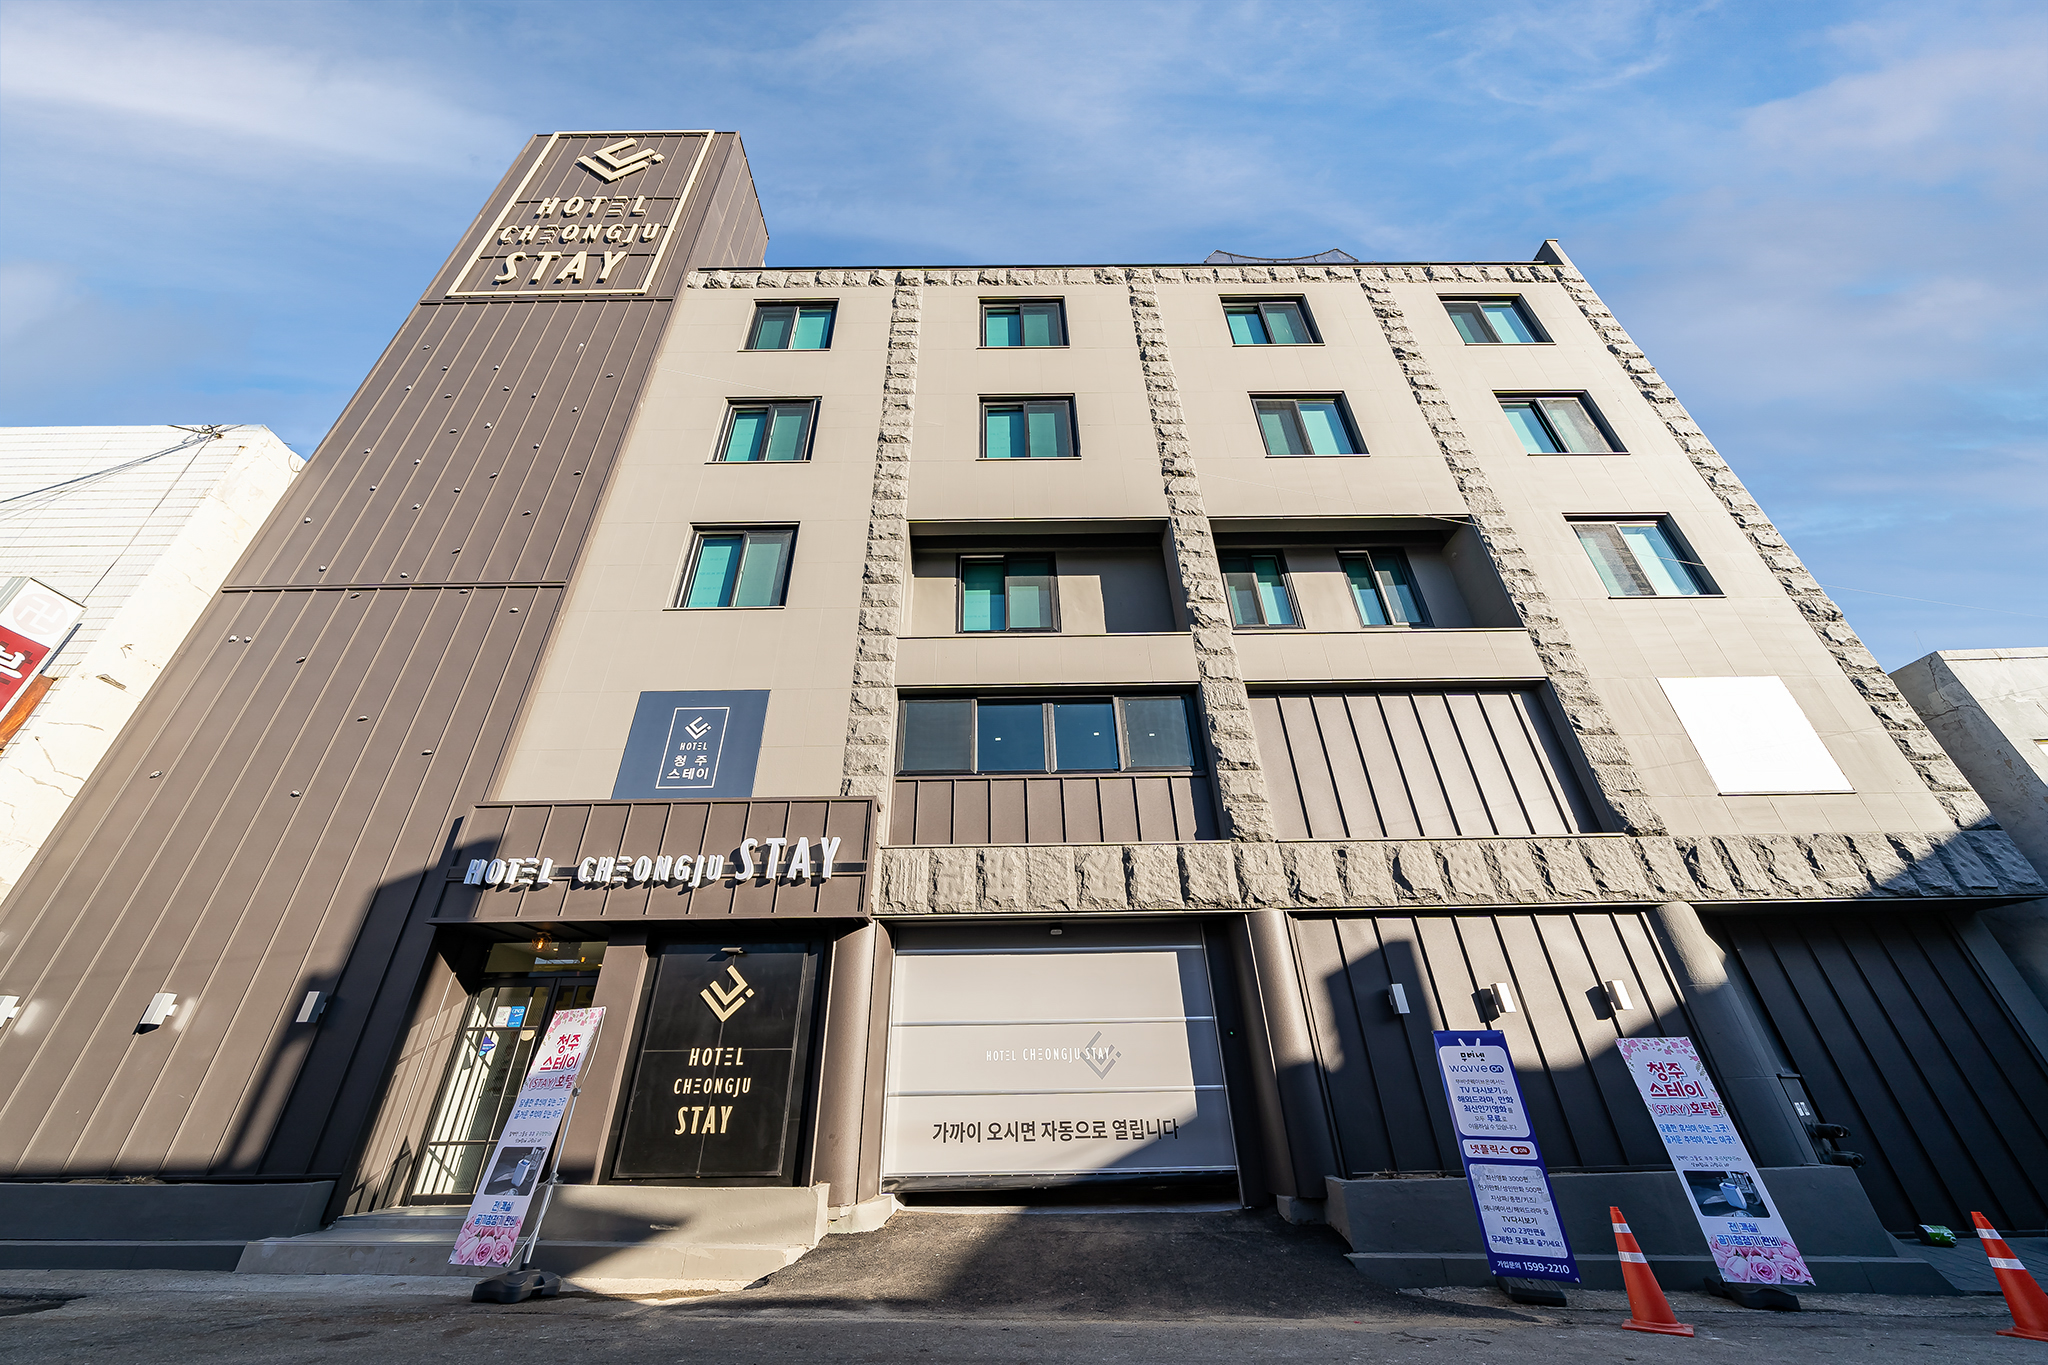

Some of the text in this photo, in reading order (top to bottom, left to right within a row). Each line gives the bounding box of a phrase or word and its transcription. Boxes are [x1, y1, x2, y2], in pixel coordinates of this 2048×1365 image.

[535, 195, 647, 216] HOTEL
[499, 223, 660, 245] CHEONGJU
[495, 250, 628, 284] STAY
[680, 742, 708, 751] HOTEL
[666, 768, 709, 780] 스테이
[463, 836, 842, 889] HOTEL CHEONGJU STAY
[556, 1034, 581, 1054] 청주
[540, 1053, 581, 1071] 스테이
[688, 1047, 744, 1066] HOTEL
[986, 1047, 1110, 1063] HOTEL CHEONGJU STAY
[1449, 1064, 1488, 1074] wavve
[1646, 1061, 1685, 1082] 청주
[529, 1074, 575, 1090] (STAY)호텔
[673, 1077, 751, 1098] CHEONGJU
[1649, 1080, 1704, 1097] 스테이
[1497, 1096, 1514, 1105] 만화
[1651, 1101, 1721, 1117] (STAY)호텔
[674, 1105, 733, 1135] STAY
[932, 1118, 1179, 1143] 가까이 오시면 자동으로 열립니다
[1470, 1144, 1509, 1155] 넷플릭스
[1491, 1235, 1513, 1245] 무제한
[1716, 1234, 1782, 1247] 공기청정기 완비
[1523, 1261, 1570, 1274] 1599-2210
